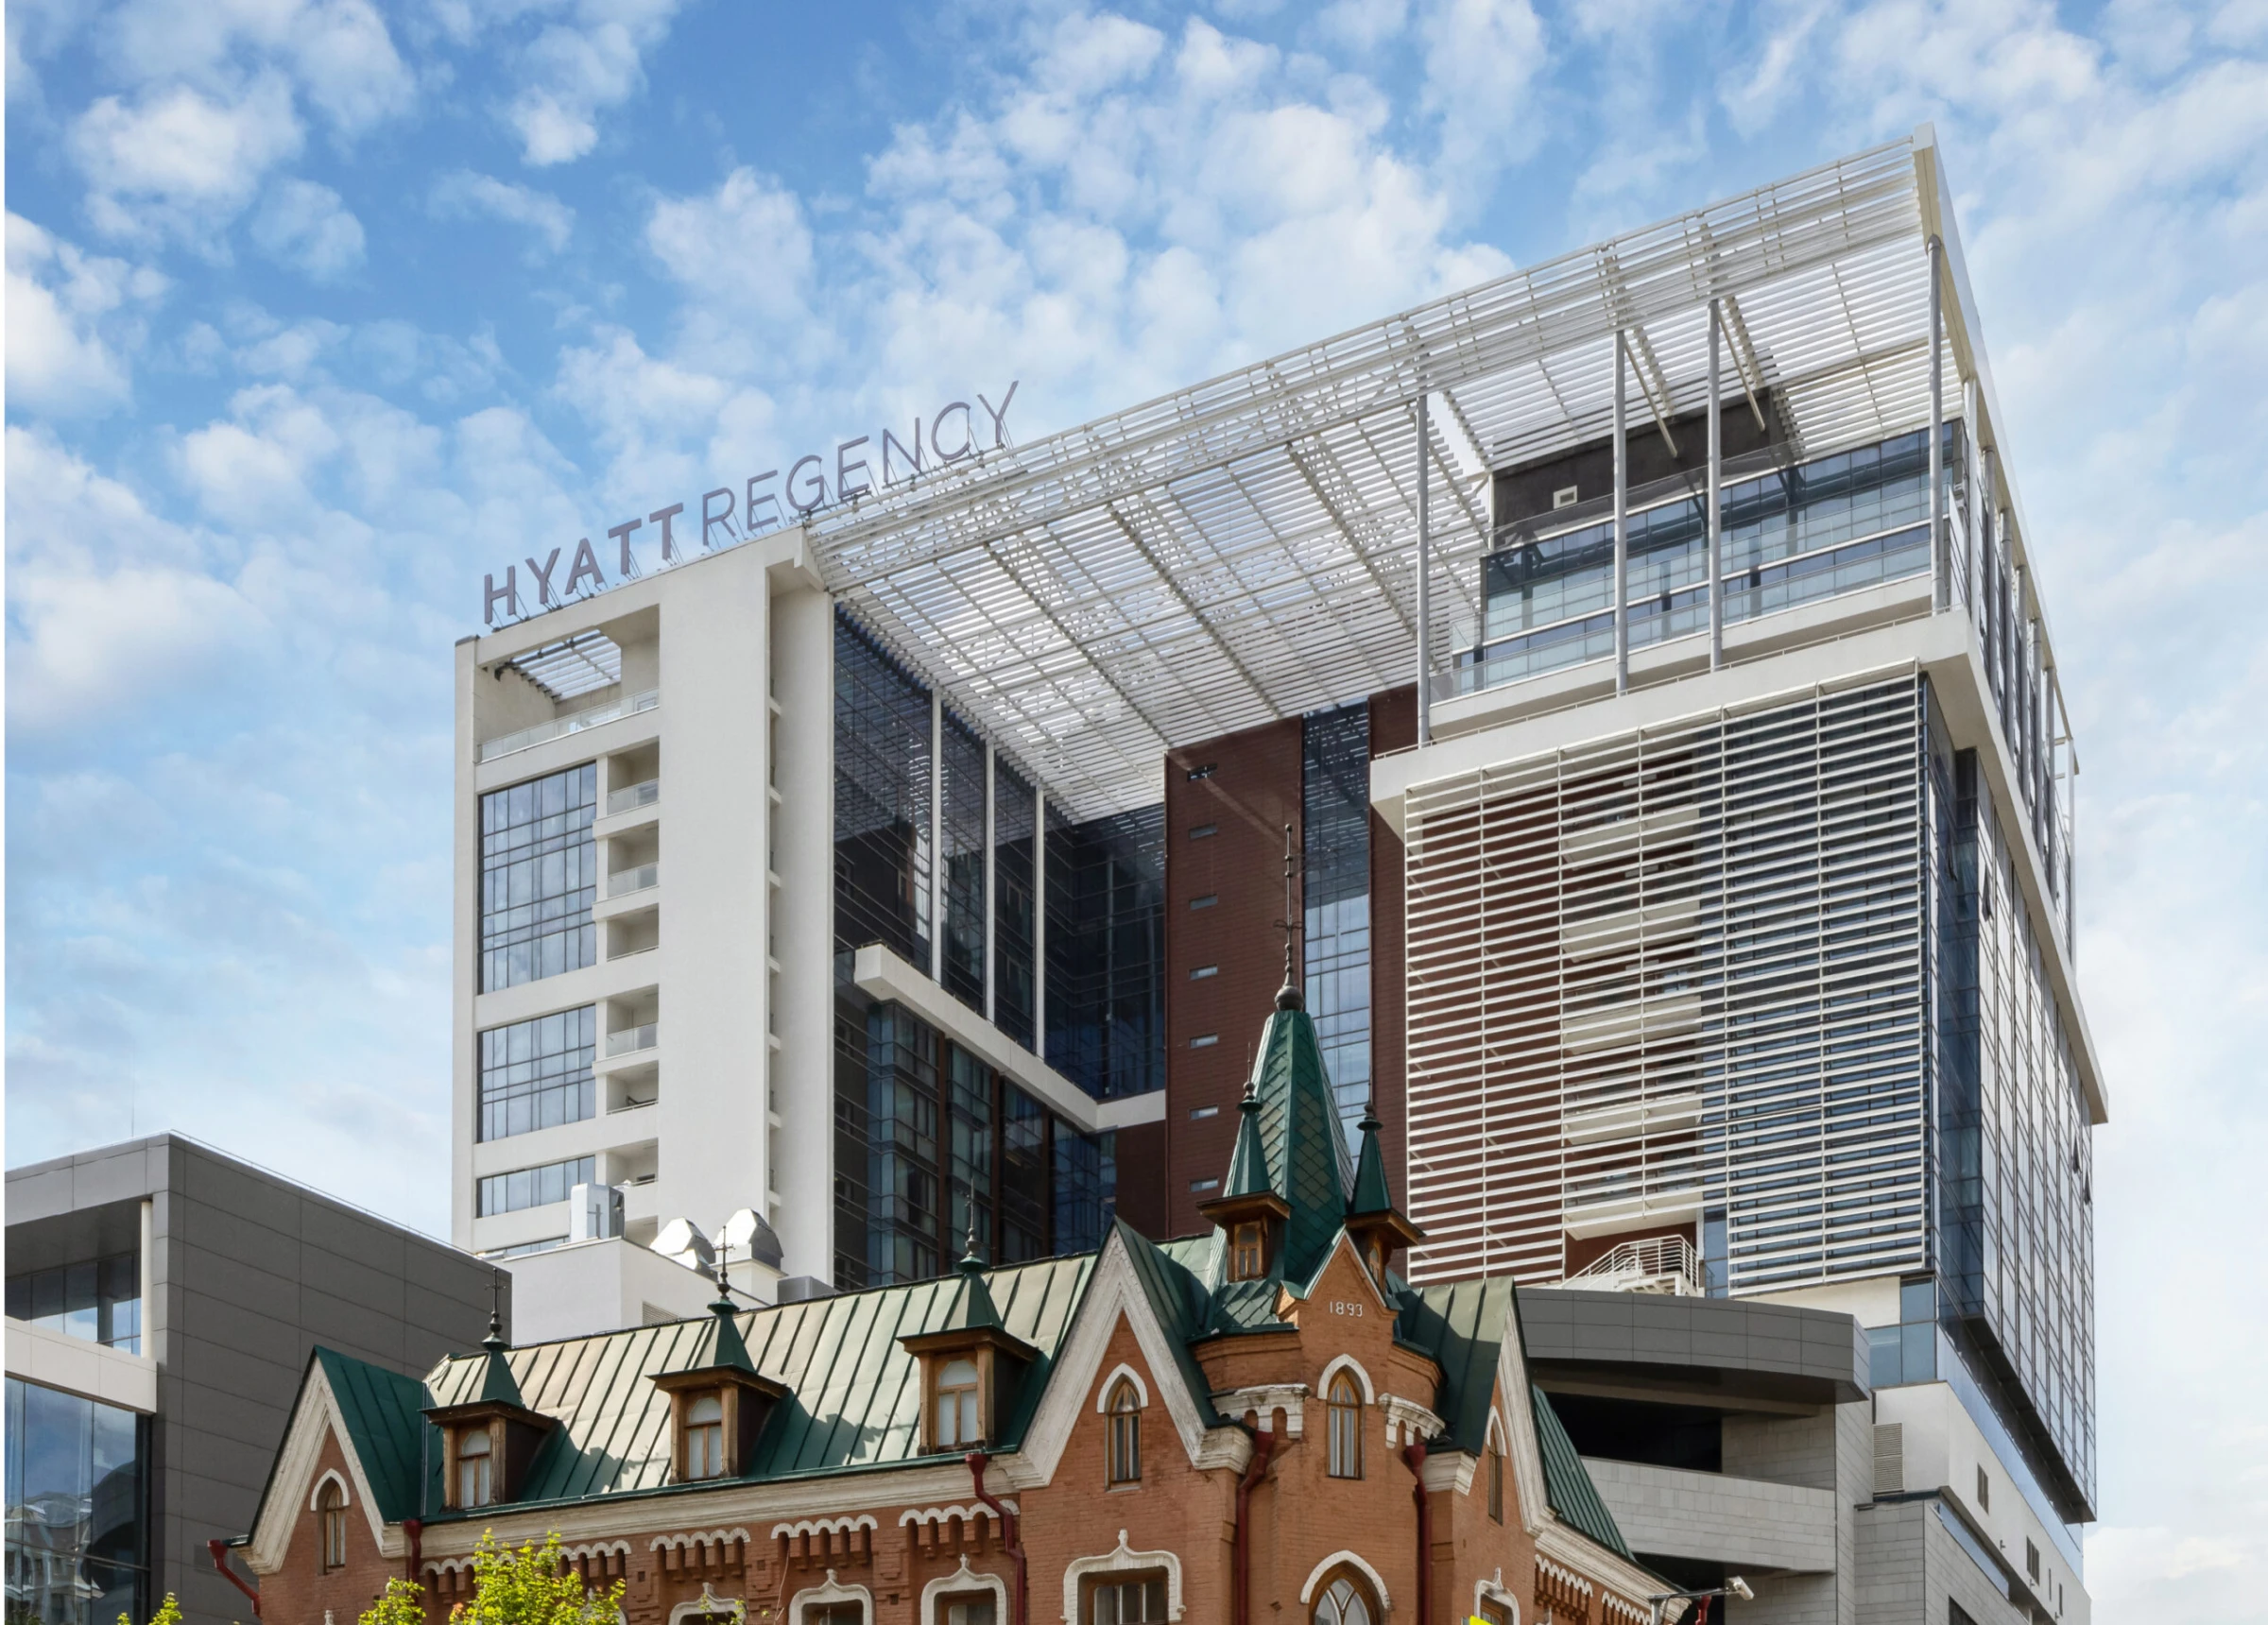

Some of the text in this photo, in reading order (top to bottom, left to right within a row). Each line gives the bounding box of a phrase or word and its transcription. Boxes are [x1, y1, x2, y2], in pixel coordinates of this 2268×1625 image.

[484, 380, 1019, 624] HYATT REGENCY
[1330, 1301, 1363, 1318] 1893
